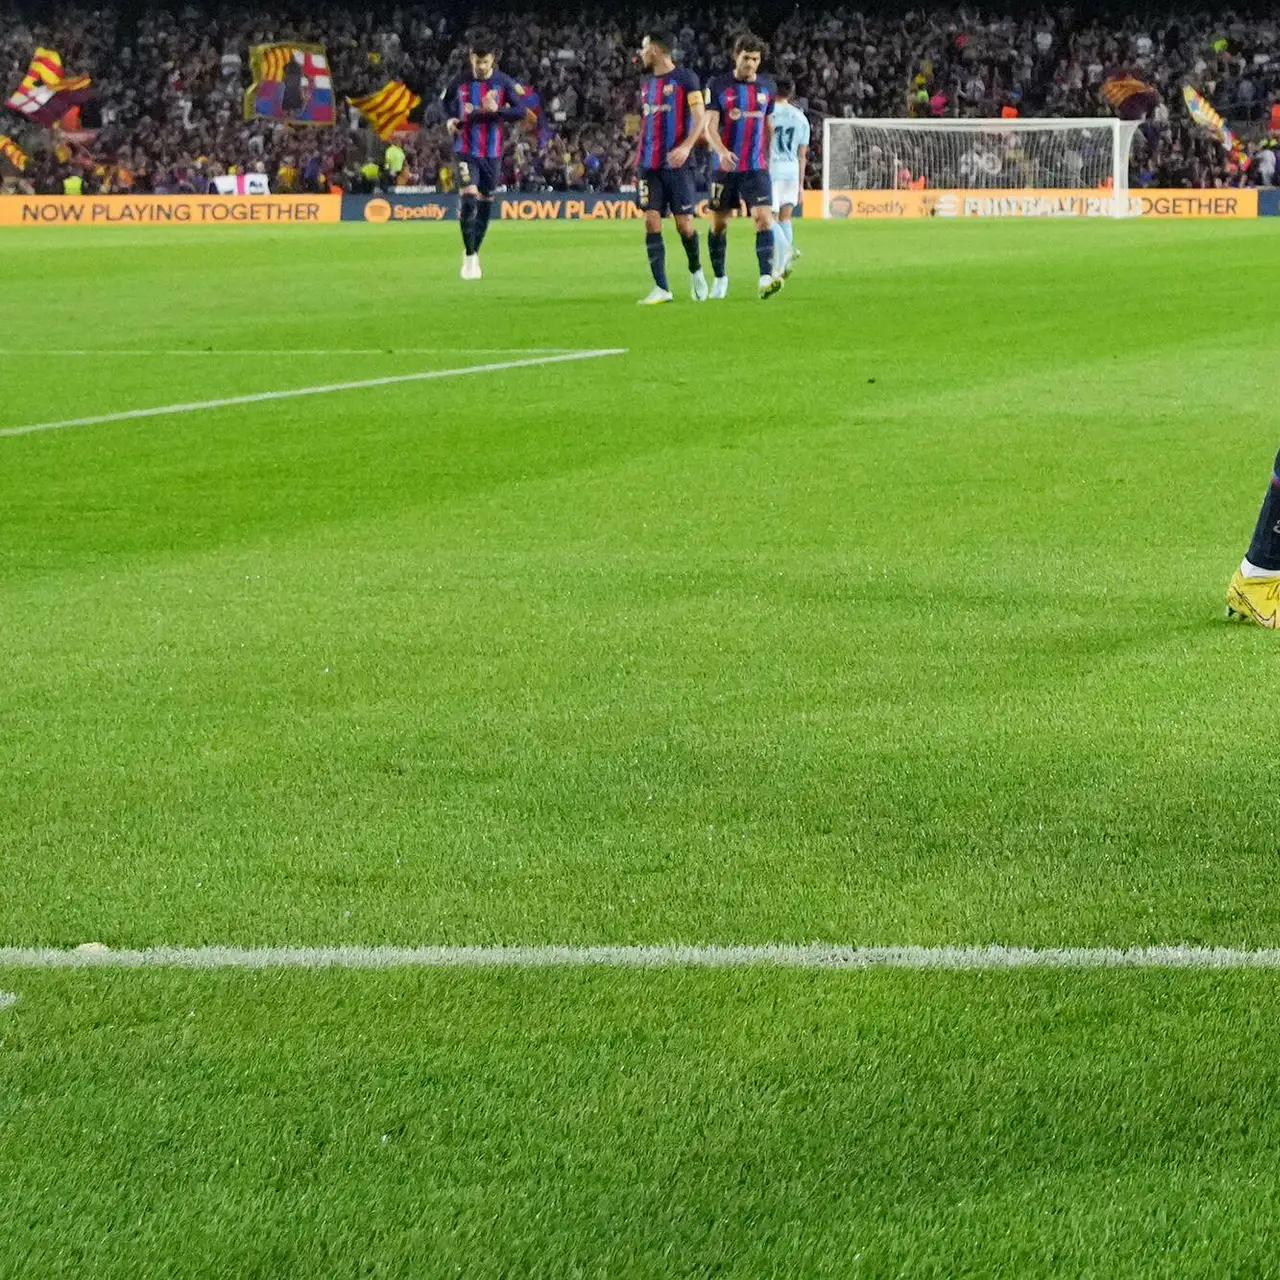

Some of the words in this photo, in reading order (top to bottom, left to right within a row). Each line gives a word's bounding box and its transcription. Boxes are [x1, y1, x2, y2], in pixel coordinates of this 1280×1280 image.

[775, 126, 795, 153] 11
[639, 179, 649, 198] 5
[22, 203, 85, 222] NOW
[92, 202, 191, 222] PLAYING
[198, 202, 320, 221] TOGETHER
[394, 203, 447, 220] Spotify
[500, 200, 562, 219] NOW
[565, 200, 648, 219] PLAYIN
[857, 200, 906, 217] Spotify
[1138, 197, 1237, 216] OGETHER
